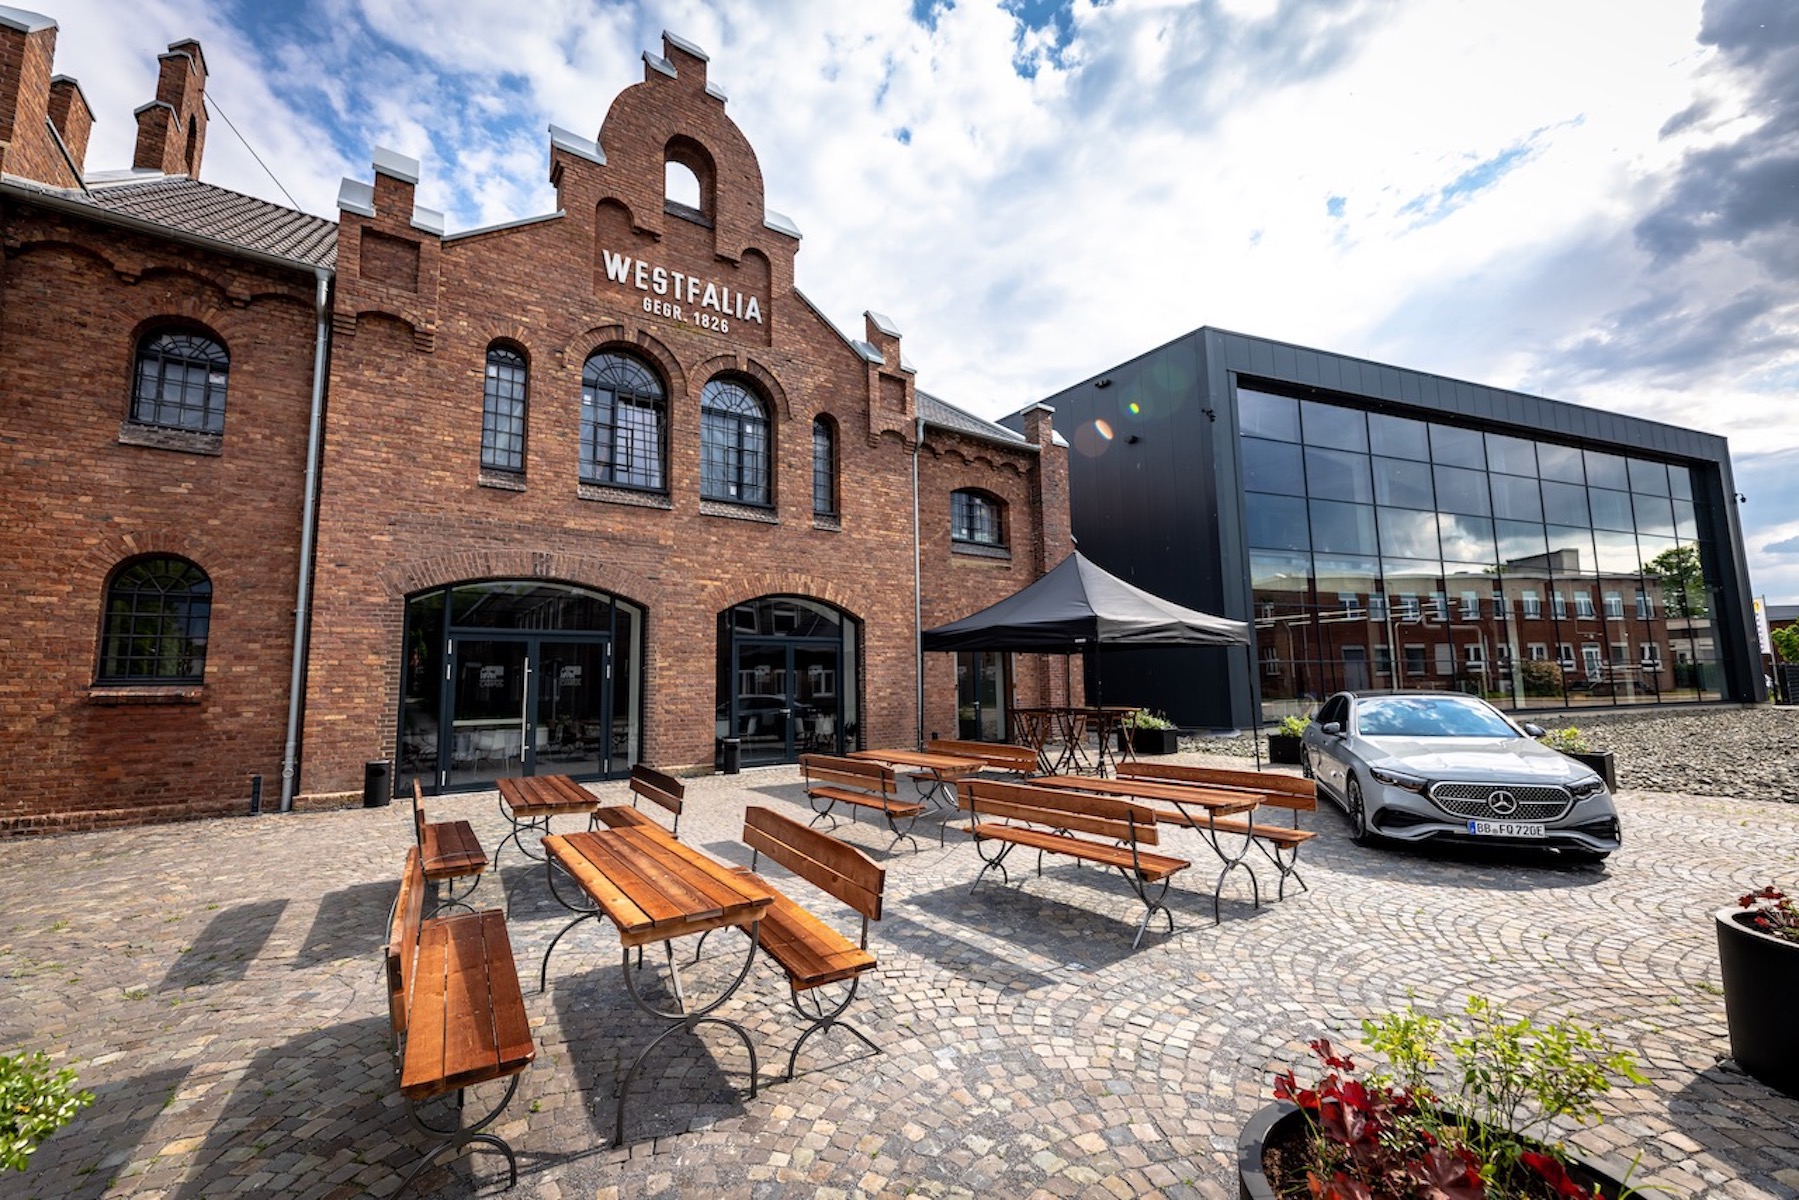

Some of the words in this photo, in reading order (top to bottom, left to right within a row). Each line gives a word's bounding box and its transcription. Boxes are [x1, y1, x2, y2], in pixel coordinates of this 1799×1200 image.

[602, 249, 763, 324] WESTFALIA
[642, 296, 688, 323] GEGR.
[693, 311, 730, 334] 1826
[1477, 823, 1491, 833] BB
